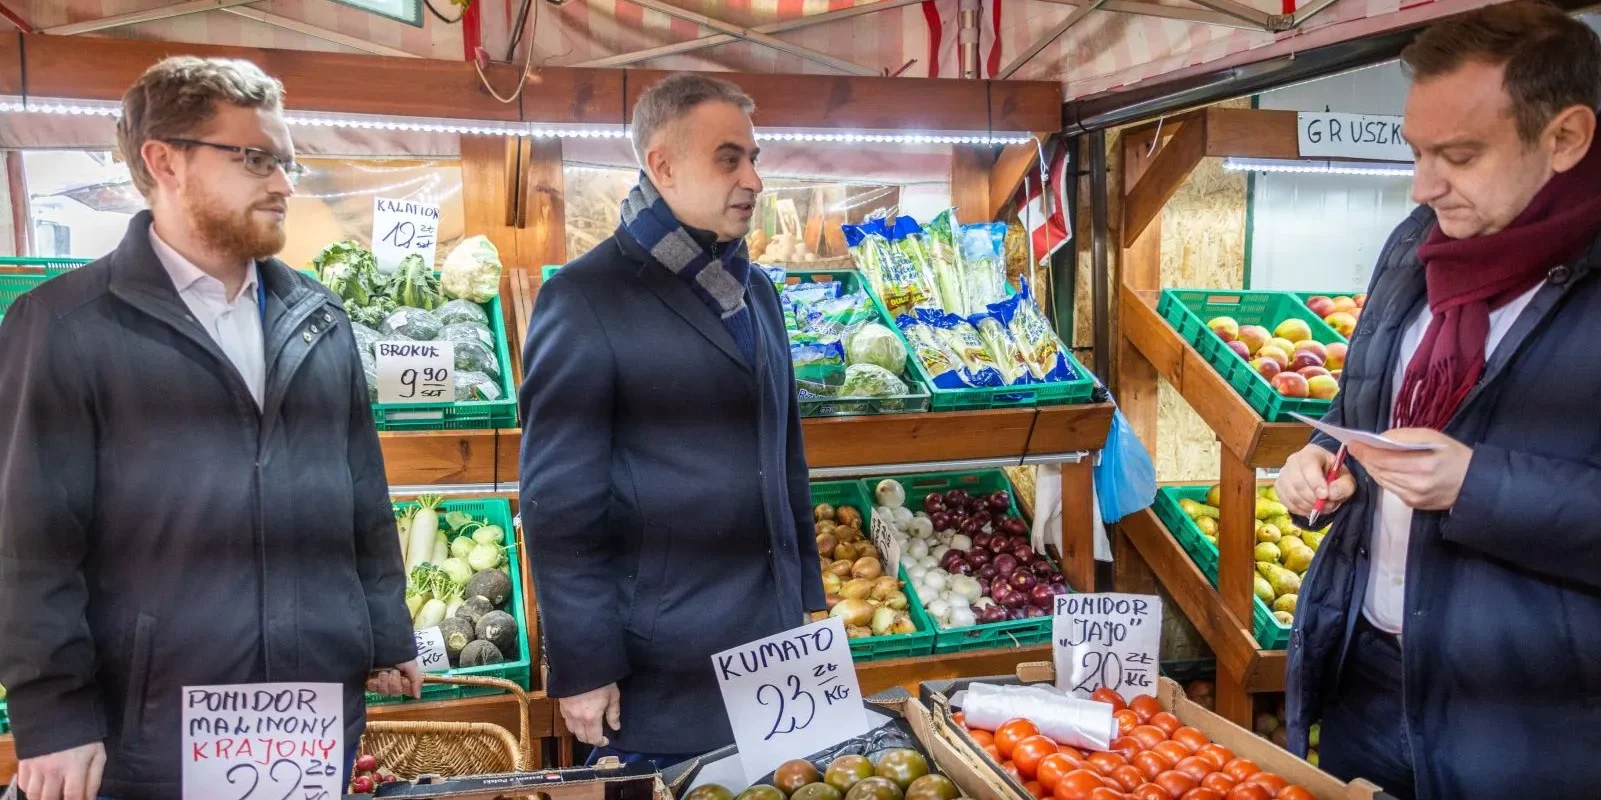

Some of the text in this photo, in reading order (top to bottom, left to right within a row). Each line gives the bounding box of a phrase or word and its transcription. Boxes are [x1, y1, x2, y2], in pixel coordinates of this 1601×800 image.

[1307, 119, 1407, 145] GRUSZK
[400, 367, 448, 398] 9 90
[1057, 597, 1149, 616] POMIDOR
[718, 627, 834, 681] KUMATO
[1072, 651, 1123, 693] 20
[1124, 672, 1153, 687] KG
[188, 688, 318, 714] POMIDOR
[756, 674, 816, 741] 23
[824, 684, 850, 706] KG
